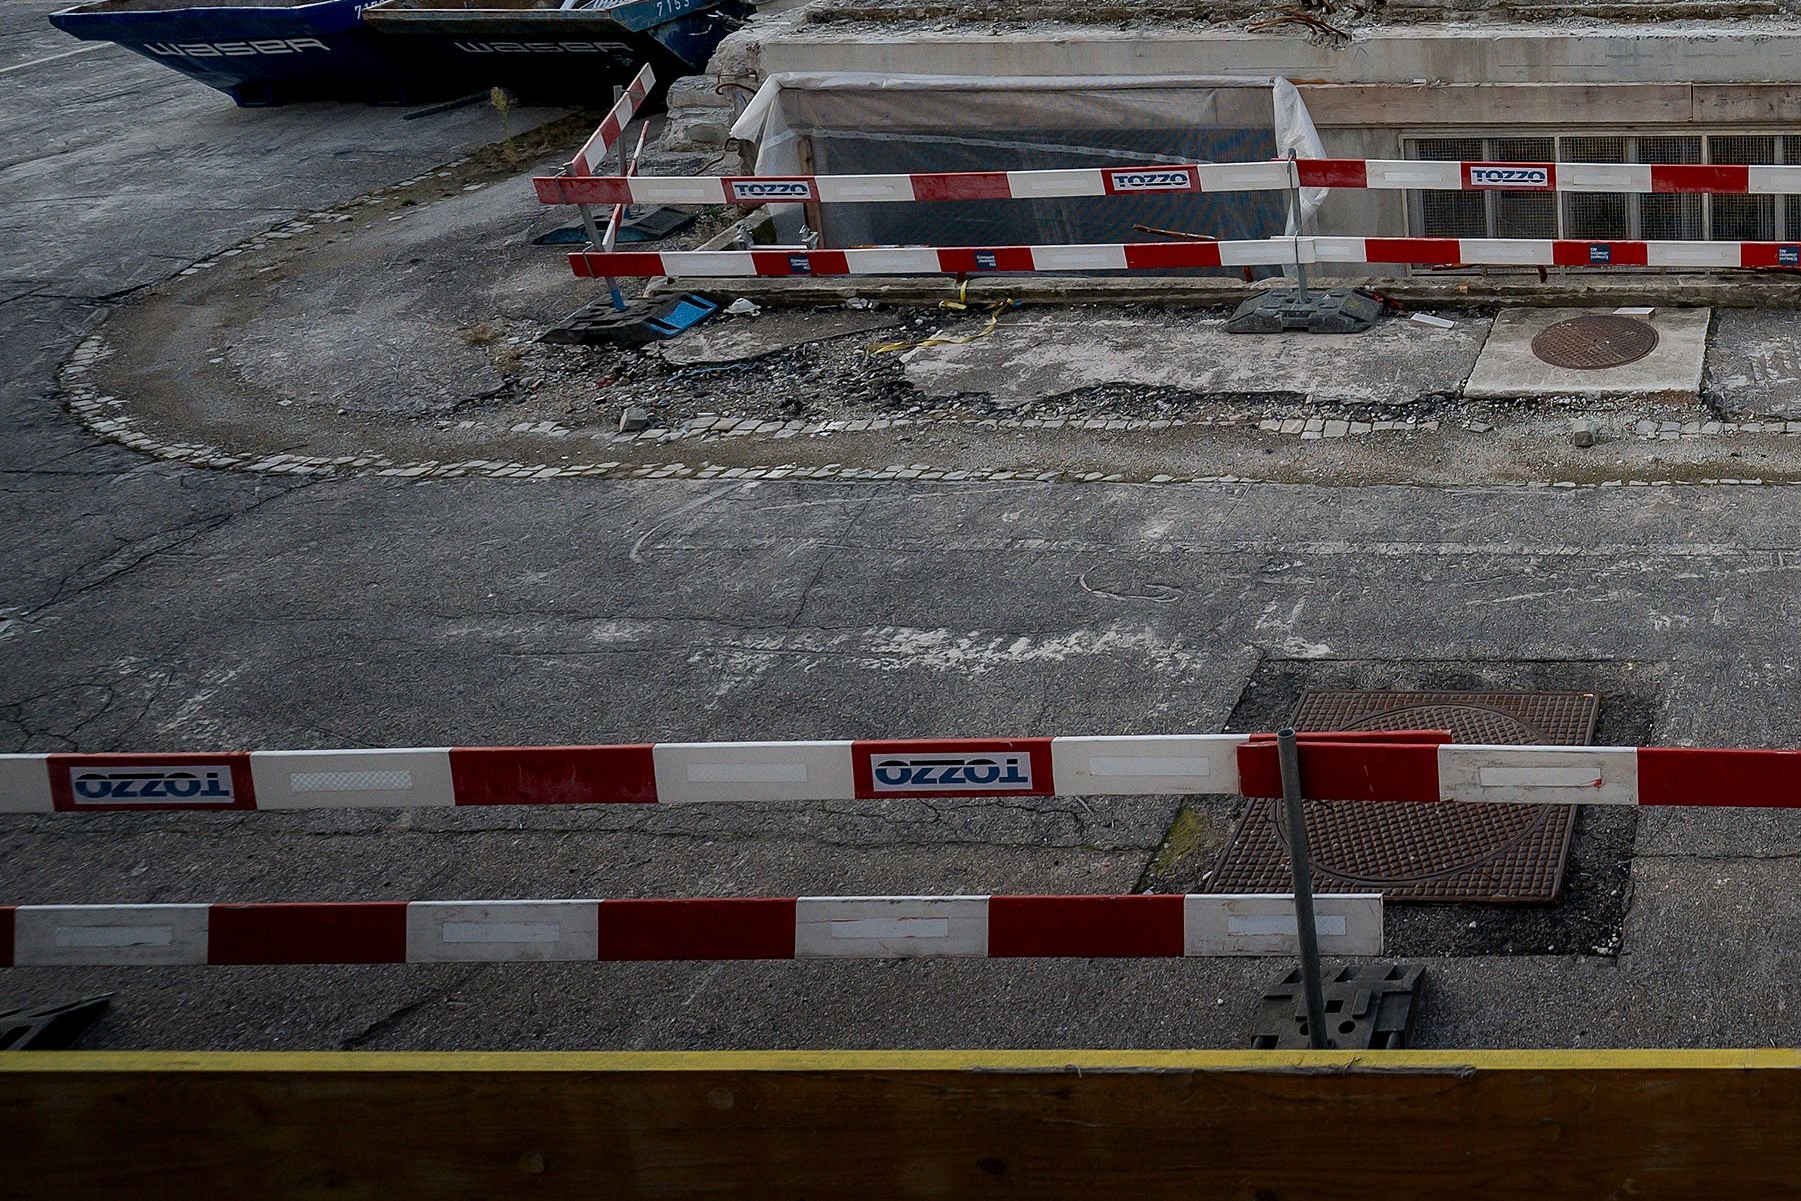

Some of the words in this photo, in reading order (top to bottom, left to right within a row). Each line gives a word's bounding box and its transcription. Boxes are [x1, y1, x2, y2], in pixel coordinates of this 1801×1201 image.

[1113, 173, 1188, 188] TOZZO
[1472, 170, 1546, 183] TOZZO
[734, 183, 808, 196] TOZZO
[874, 758, 1027, 785] TOZZO
[74, 772, 230, 798] TOZZO
